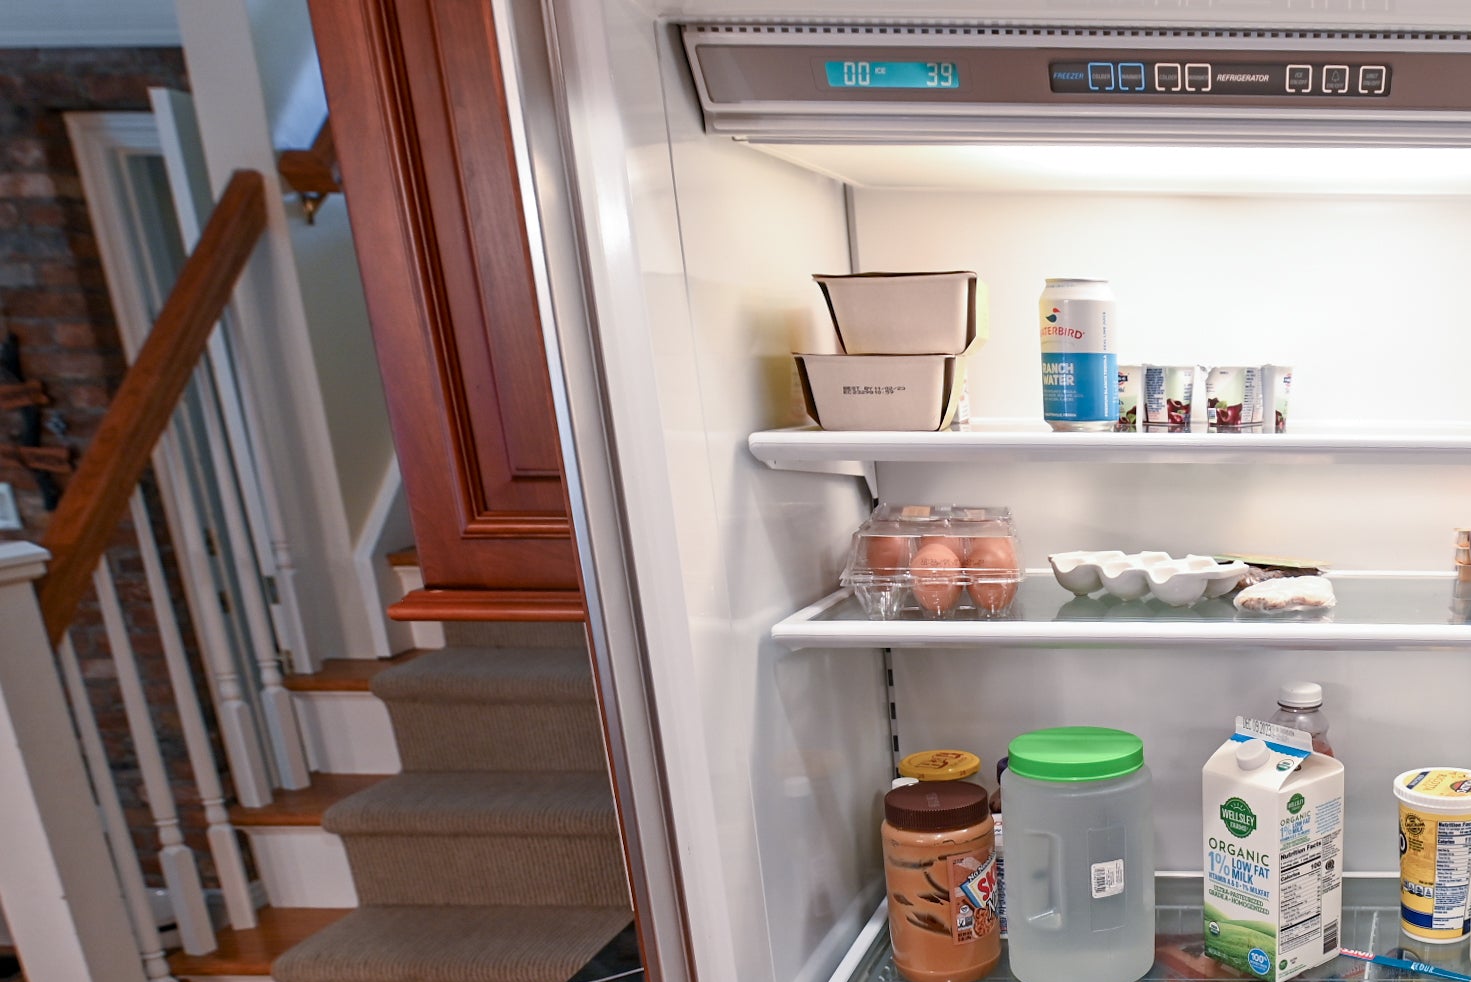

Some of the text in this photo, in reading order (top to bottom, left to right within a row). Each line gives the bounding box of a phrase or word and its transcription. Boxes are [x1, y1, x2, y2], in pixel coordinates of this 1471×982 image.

[844, 62, 870, 86] 00
[926, 62, 952, 87] 39
[1053, 72, 1085, 80] FREEZER
[1216, 74, 1270, 83] REFRIGERATOR
[1042, 363, 1074, 374] RANCH
[1042, 374, 1075, 386] WATER
[1221, 808, 1255, 827] WELLSLEY
[1280, 810, 1312, 827] ORGANIC
[1208, 837, 1270, 867] ORGANIC
[1280, 841, 1322, 861] Nutrition Facts
[1208, 851, 1271, 879] 1% LOW FAT
[1310, 860, 1322, 870] 100
[1232, 868, 1254, 885] MILK
[1280, 871, 1301, 882] Calories
